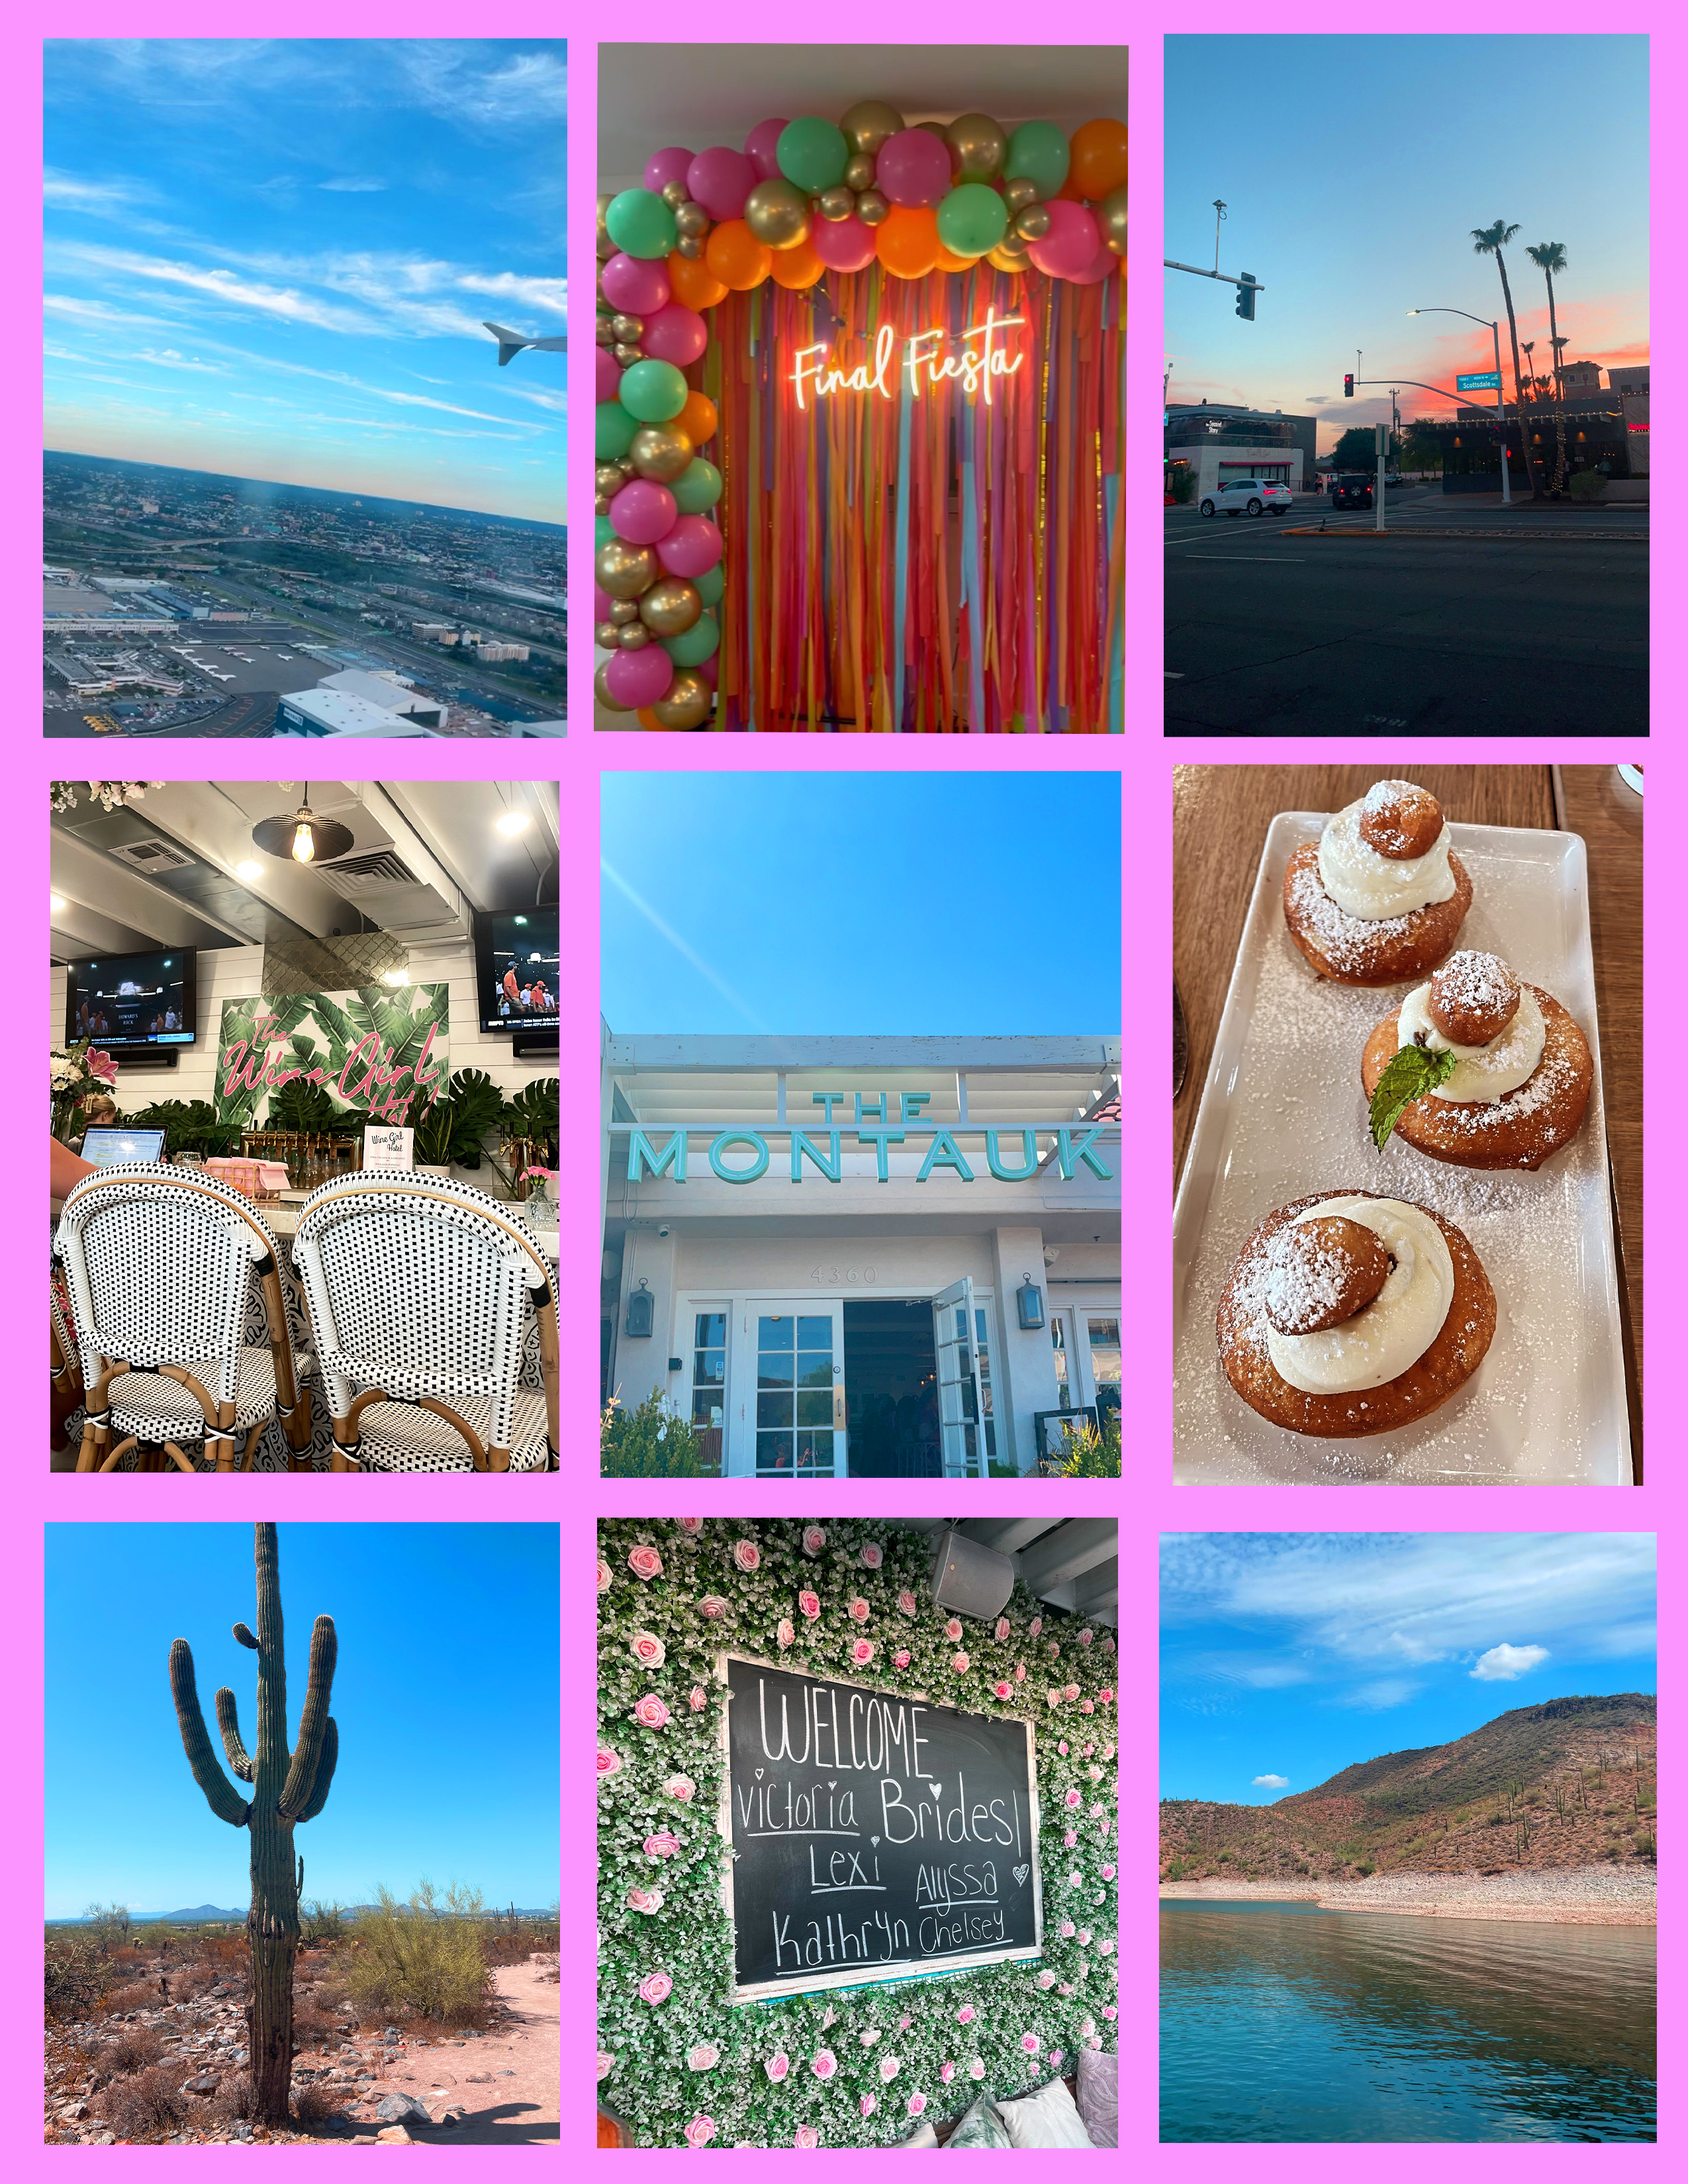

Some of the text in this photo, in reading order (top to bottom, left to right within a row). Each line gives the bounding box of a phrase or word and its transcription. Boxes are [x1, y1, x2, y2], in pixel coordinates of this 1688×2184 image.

[789, 306, 1025, 410] Final Fiesta
[250, 1013, 294, 1047] The
[223, 1022, 440, 1099] Wine Girl
[812, 1092, 933, 1124] THE
[371, 1131, 404, 1145] Wine Girl
[627, 1129, 1114, 1184] MONTAUK
[811, 1265, 878, 1283] 4360
[759, 1678, 933, 1779] WELCOME
[810, 1837, 999, 1917] Lexi Alyssa
[772, 1910, 1006, 1967] Kathryn Chelsey
